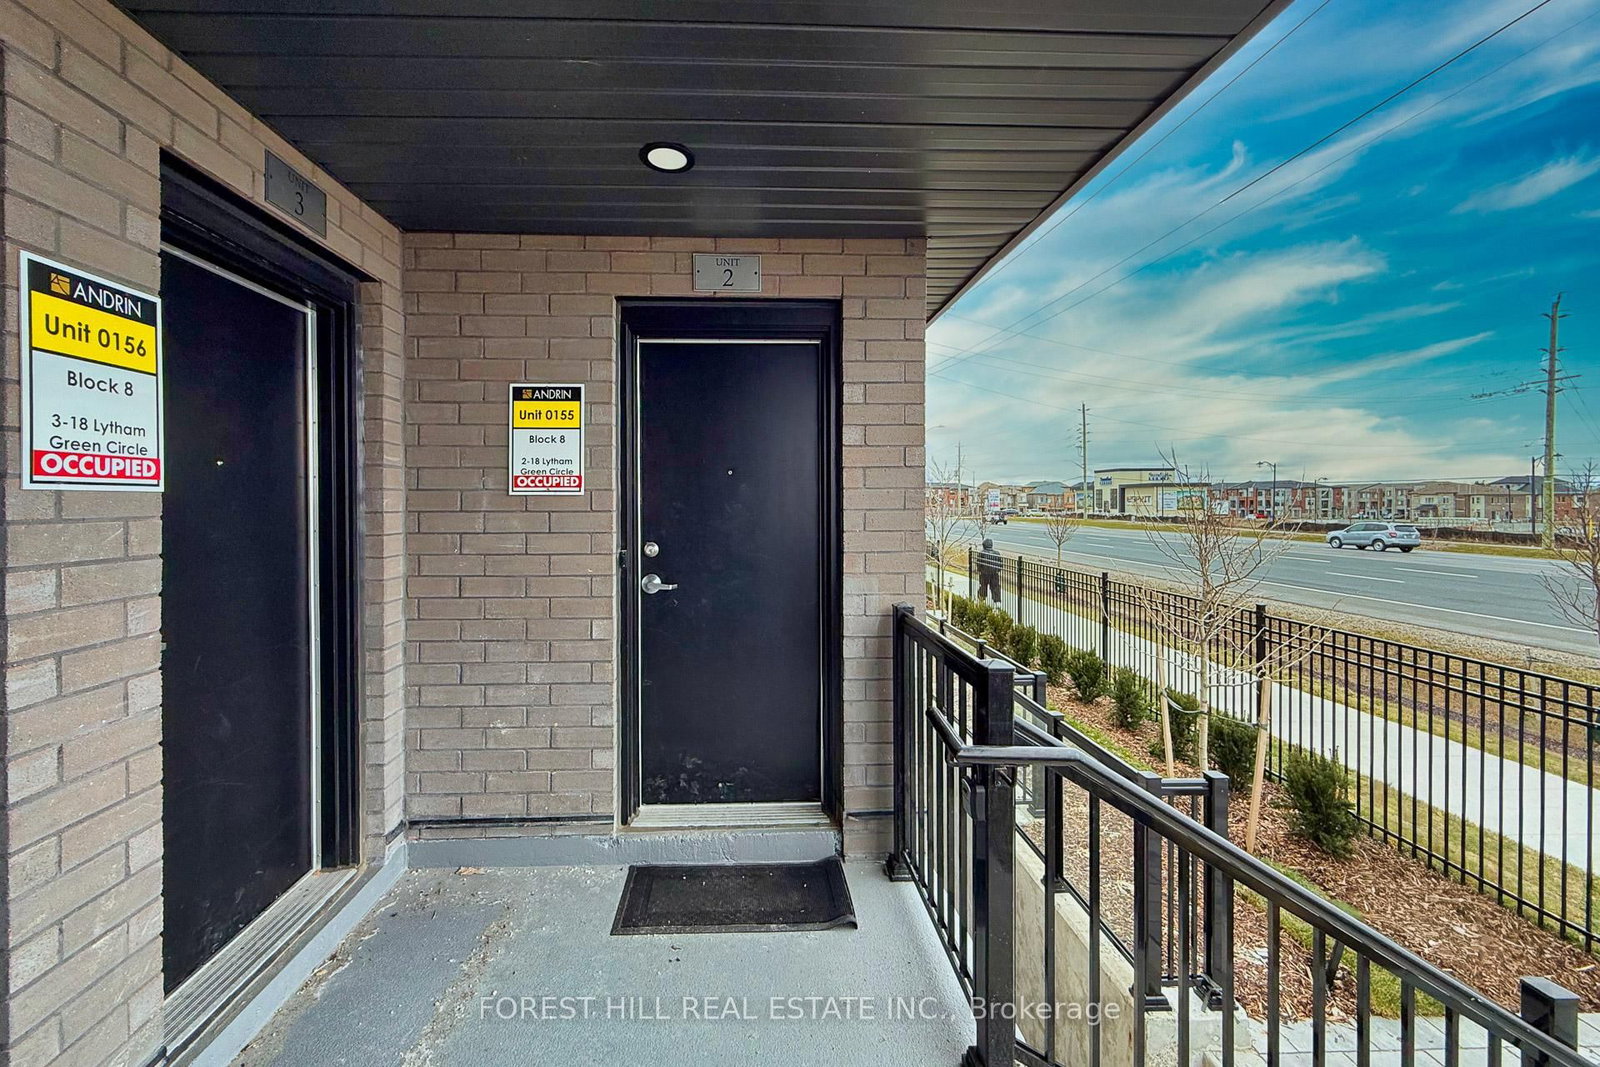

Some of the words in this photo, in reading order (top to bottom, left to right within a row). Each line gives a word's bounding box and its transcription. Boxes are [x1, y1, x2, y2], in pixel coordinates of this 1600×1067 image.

[295, 191, 304, 216] 3
[716, 258, 740, 266] UNIT
[722, 268, 734, 287] 2
[73, 282, 141, 319] ANDRIN
[44, 313, 91, 344] Unit
[97, 328, 147, 358] 0156
[67, 370, 119, 395] Block
[124, 382, 134, 397] 8
[533, 389, 571, 399] ANDRIN
[519, 410, 542, 420] Unit
[545, 410, 574, 420] 0155
[51, 413, 89, 431] 3-18
[93, 418, 146, 438] Lytham
[49, 435, 101, 453] Green
[106, 440, 148, 456] Circle
[529, 435, 557, 444] Block
[559, 435, 566, 444] 8
[40, 453, 157, 478] OCCUPIED
[520, 468, 547, 476] Green
[549, 467, 574, 476] Circle
[521, 457, 540, 466] 2-18
[542, 457, 573, 467] Lytham
[517, 477, 579, 487] OCCUPIED
